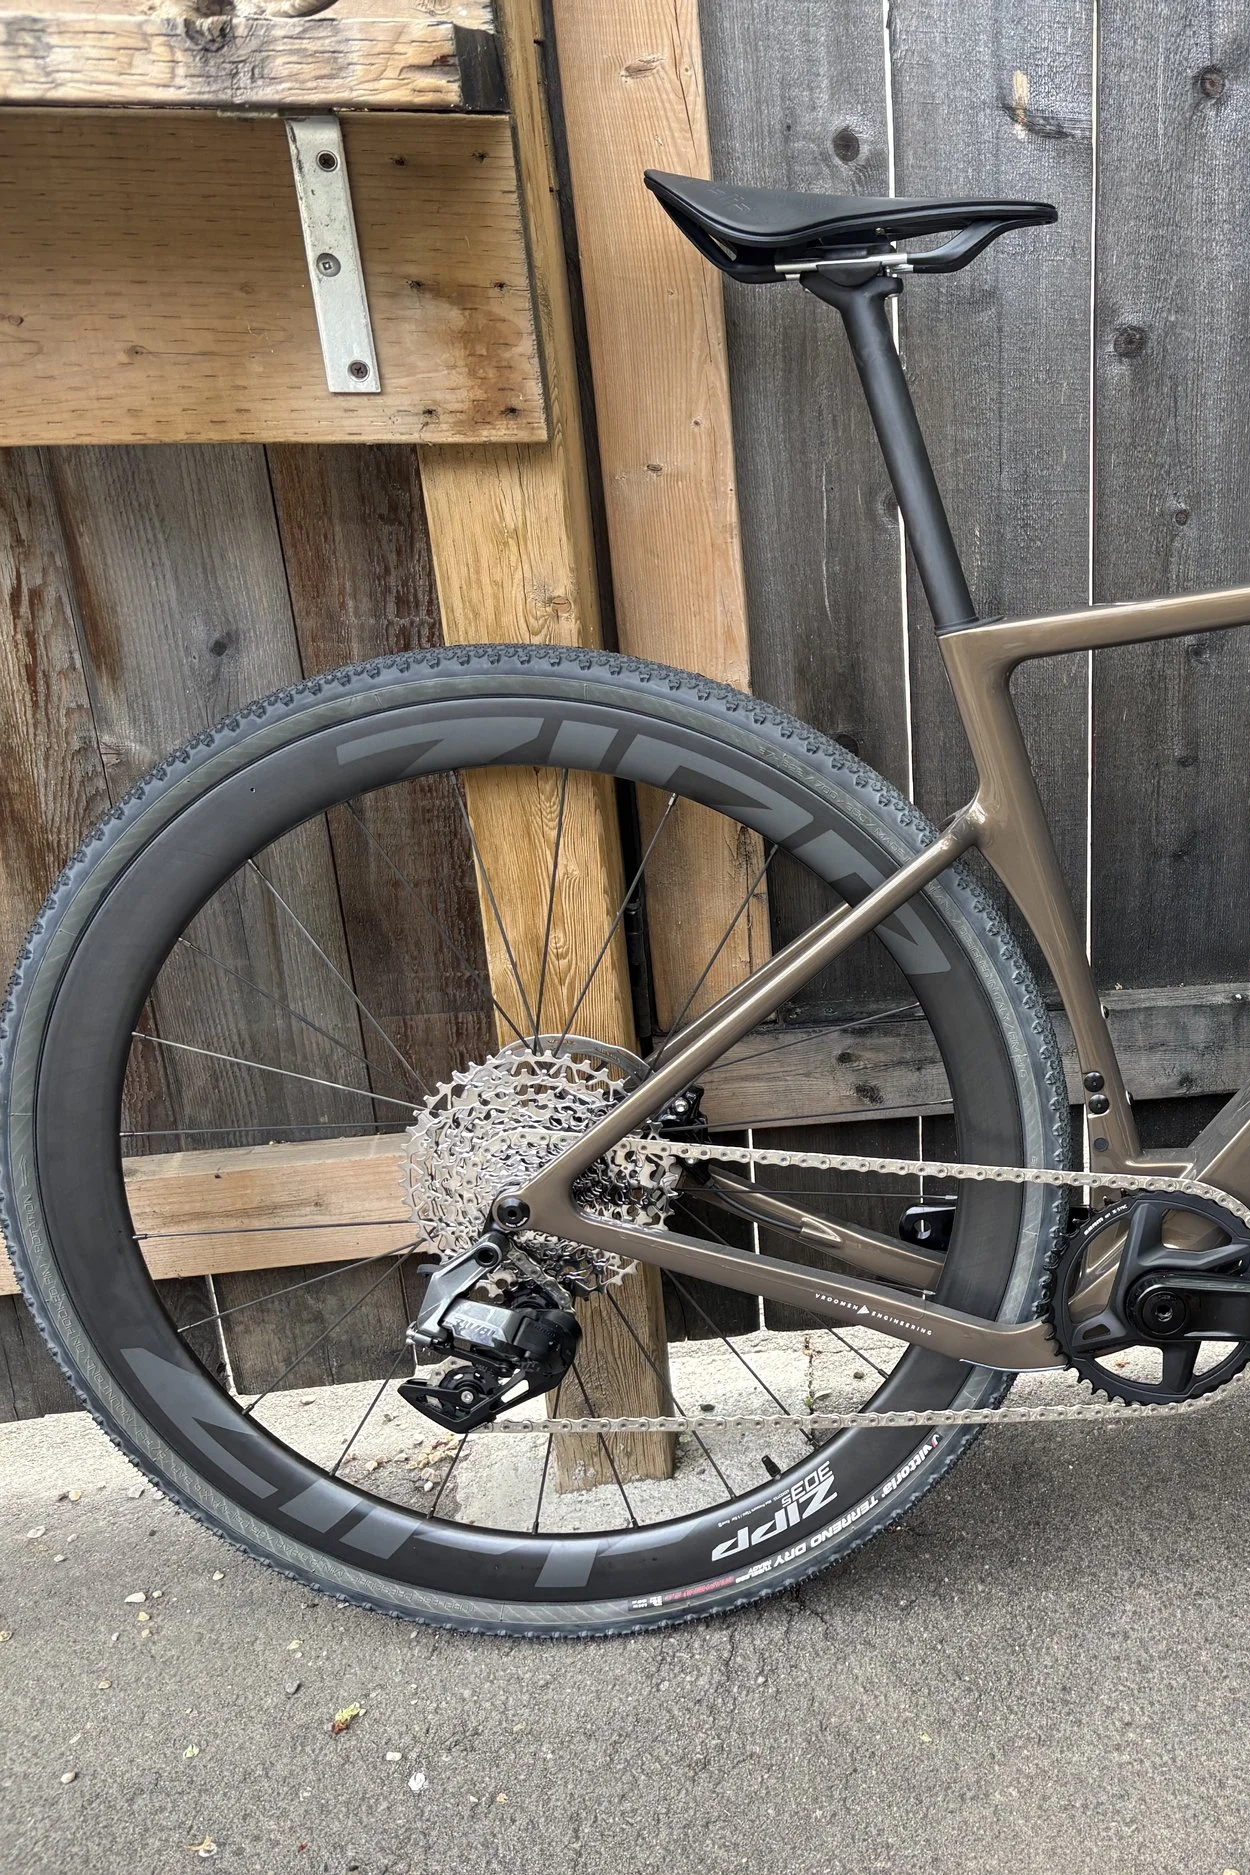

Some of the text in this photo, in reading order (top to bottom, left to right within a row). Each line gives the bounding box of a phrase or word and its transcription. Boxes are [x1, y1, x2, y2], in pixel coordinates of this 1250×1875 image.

[22, 1193, 44, 1253] ROTATION
[47, 1286, 77, 1335] HOOKED
[815, 1293, 932, 1335] VROOMEN ENGINEERING
[70, 1334, 86, 1354] ON
[80, 1352, 105, 1384] ONLY
[100, 1383, 134, 1424] MOUNT
[884, 1441, 937, 1494] vittoria
[711, 1474, 838, 1562] ZIPP
[811, 1496, 879, 1546] TERRENO
[773, 1544, 807, 1568] DRY
